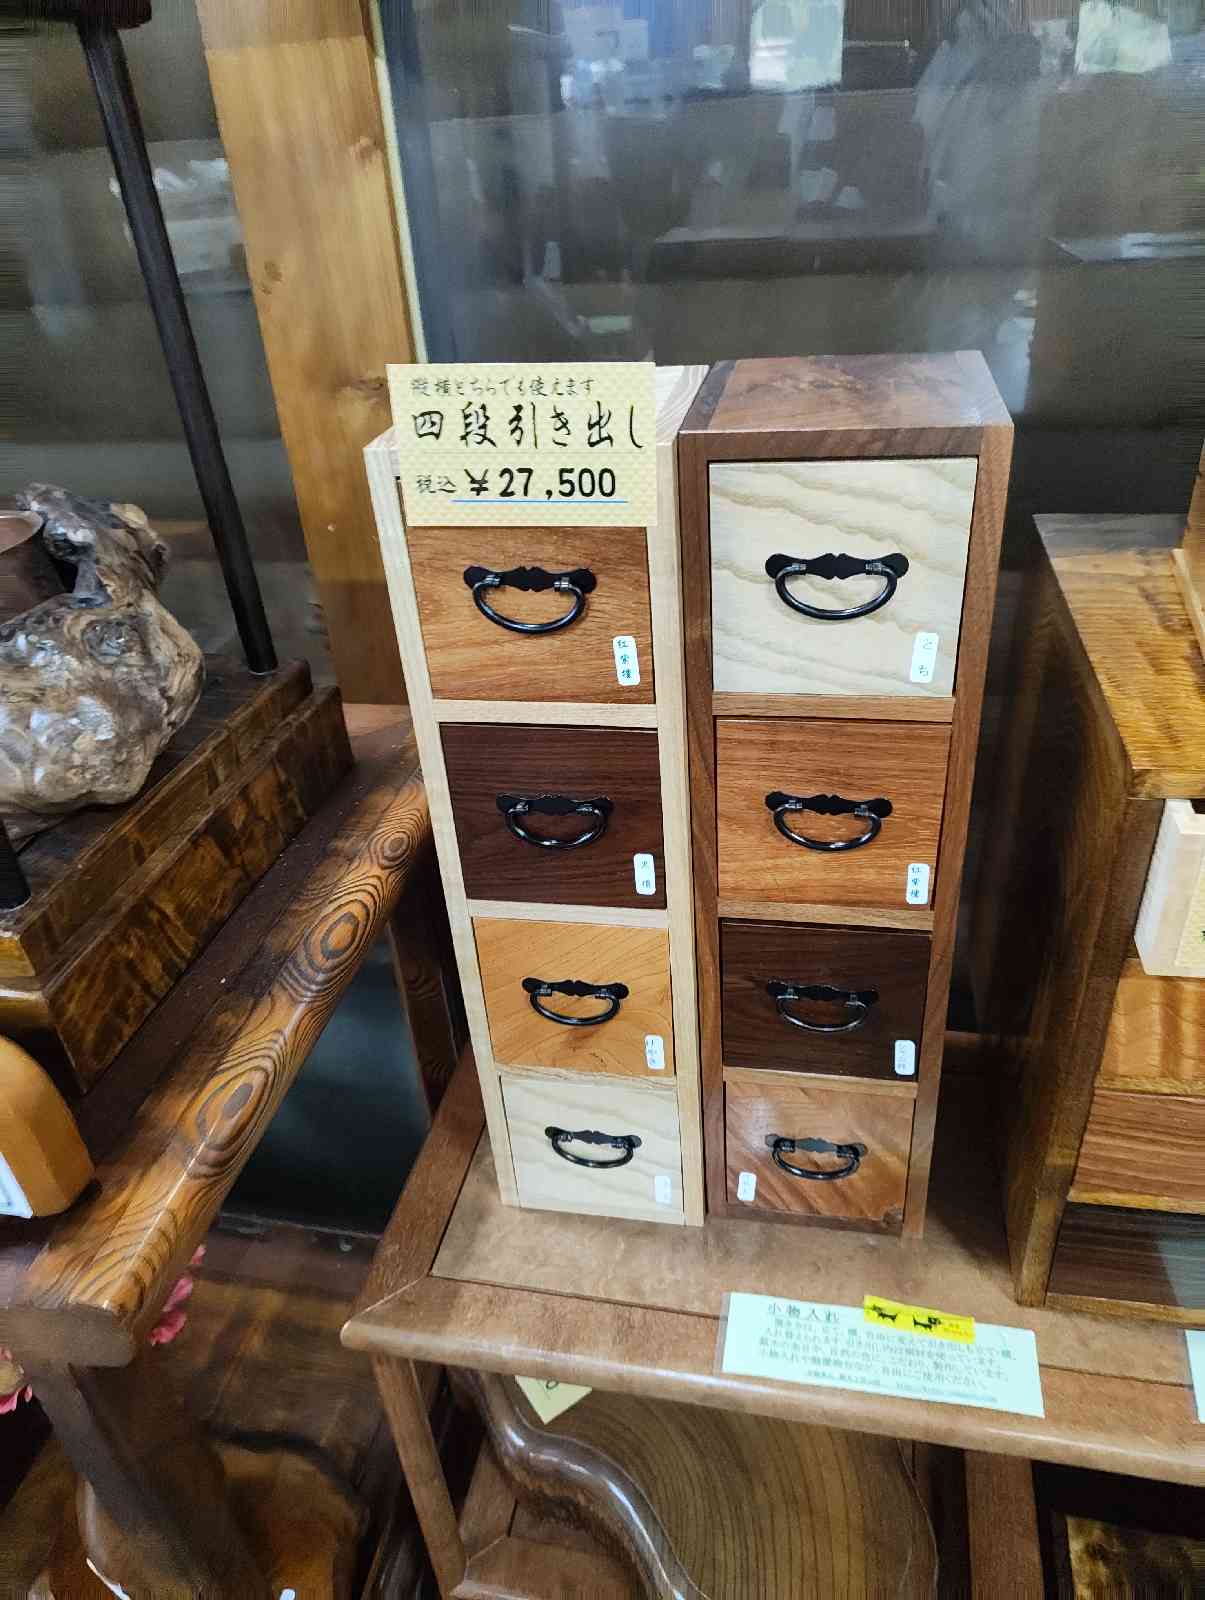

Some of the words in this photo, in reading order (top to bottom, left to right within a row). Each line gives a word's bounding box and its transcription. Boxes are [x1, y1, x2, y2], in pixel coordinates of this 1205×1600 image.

[411, 400, 644, 450] 四段引き出し
[415, 473, 457, 495] 税込
[766, 1302, 840, 1325] 小物入れ
